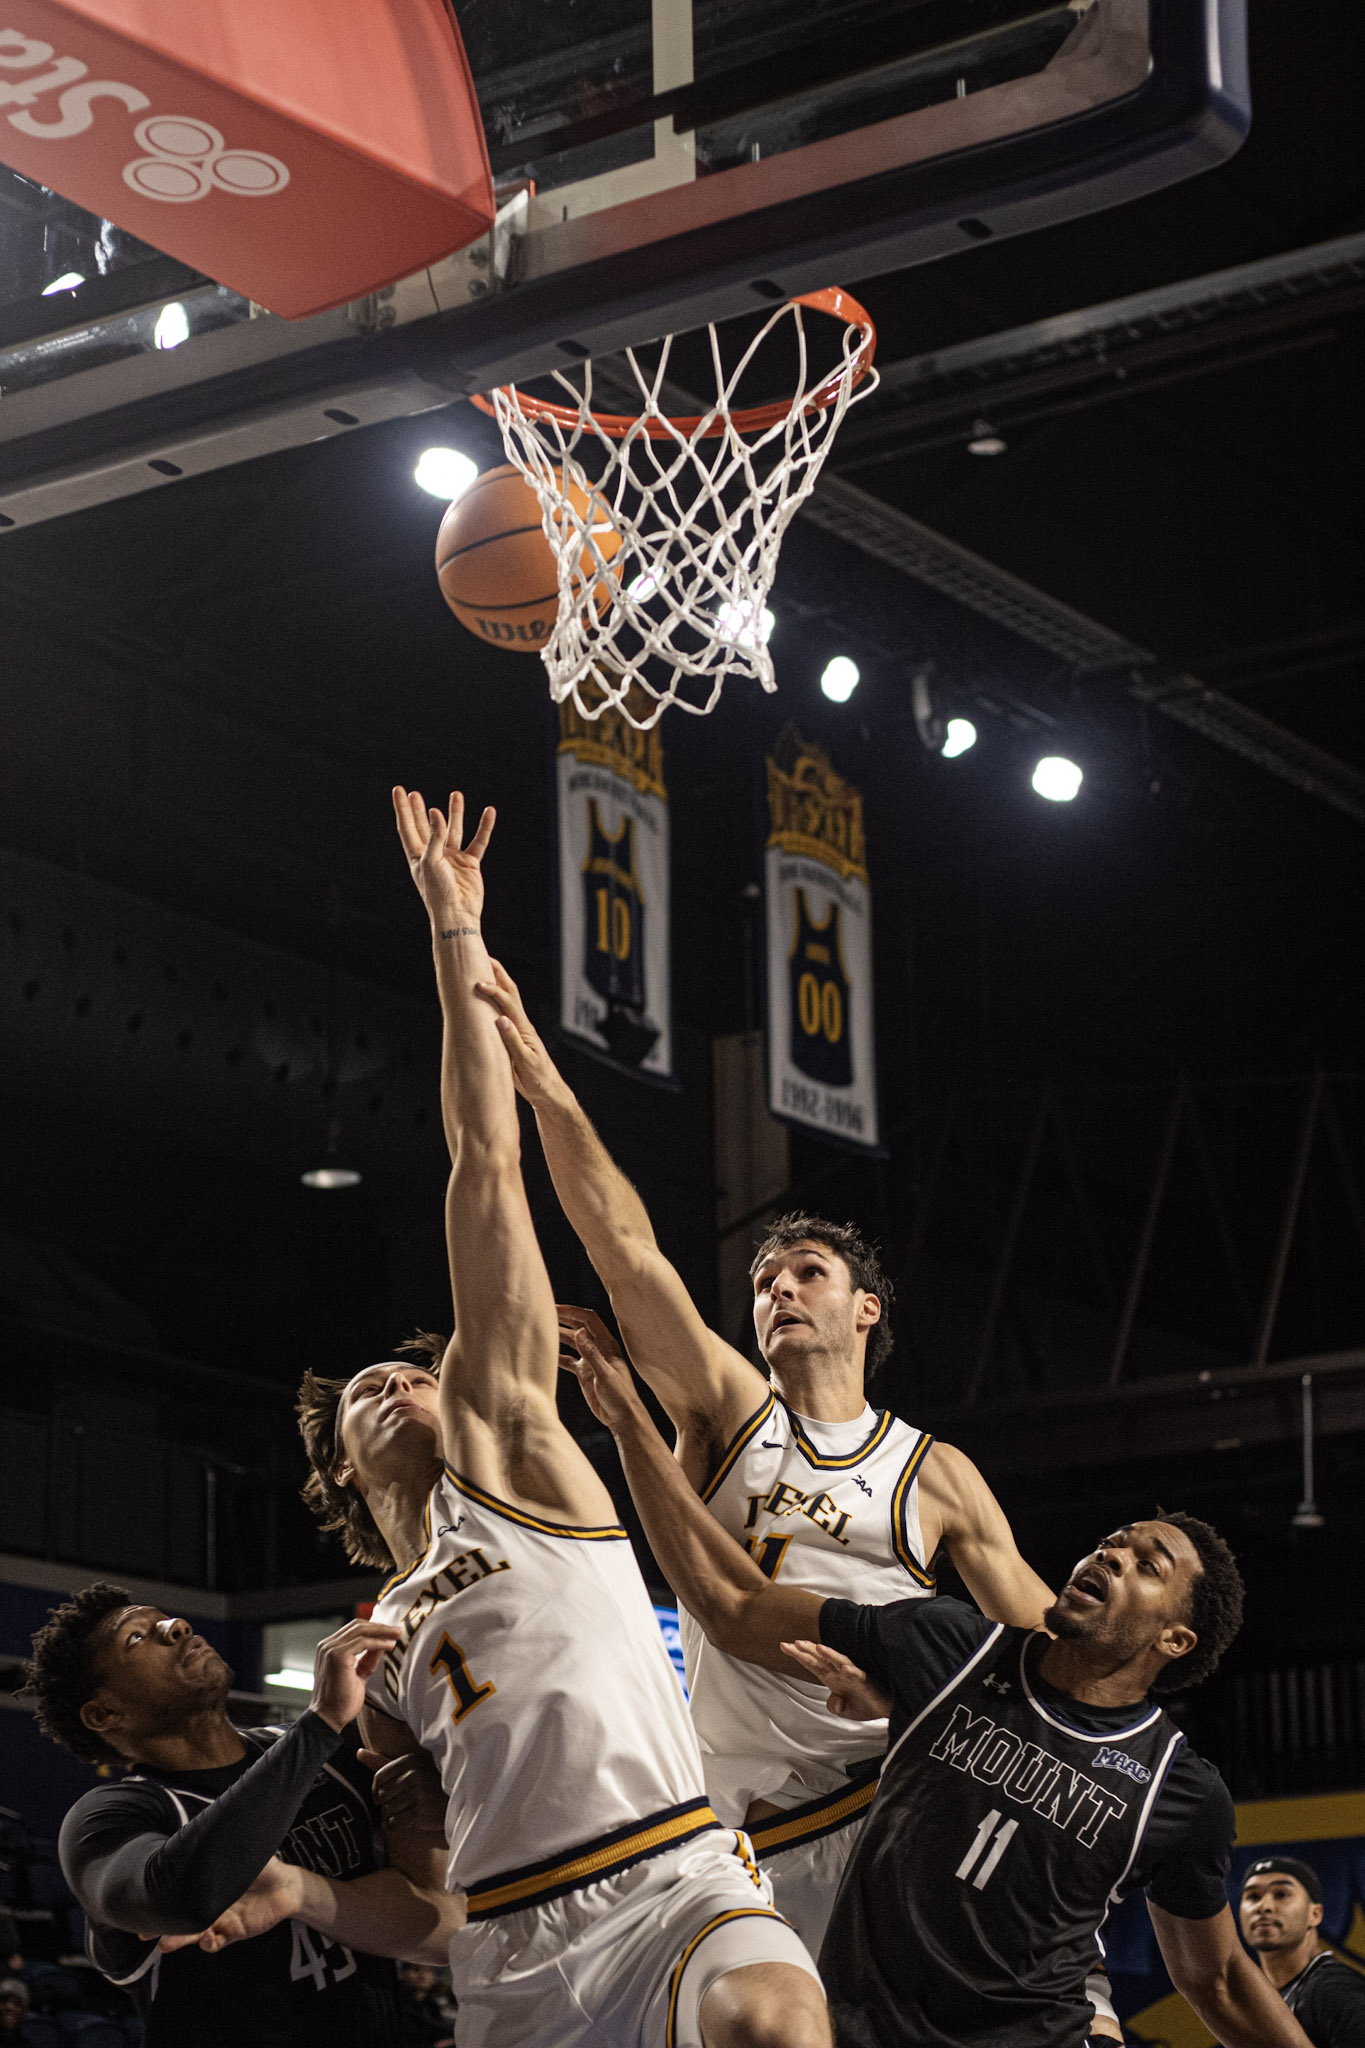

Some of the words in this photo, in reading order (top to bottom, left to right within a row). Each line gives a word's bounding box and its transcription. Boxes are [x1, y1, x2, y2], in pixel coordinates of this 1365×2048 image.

[0, 28, 150, 139] Sta
[799, 973, 842, 1044] 00
[429, 1630, 497, 1727] 1
[928, 1703, 1128, 1850] MOUNT
[1091, 1746, 1152, 1784] MAAC
[954, 1808, 1020, 1891] 11
